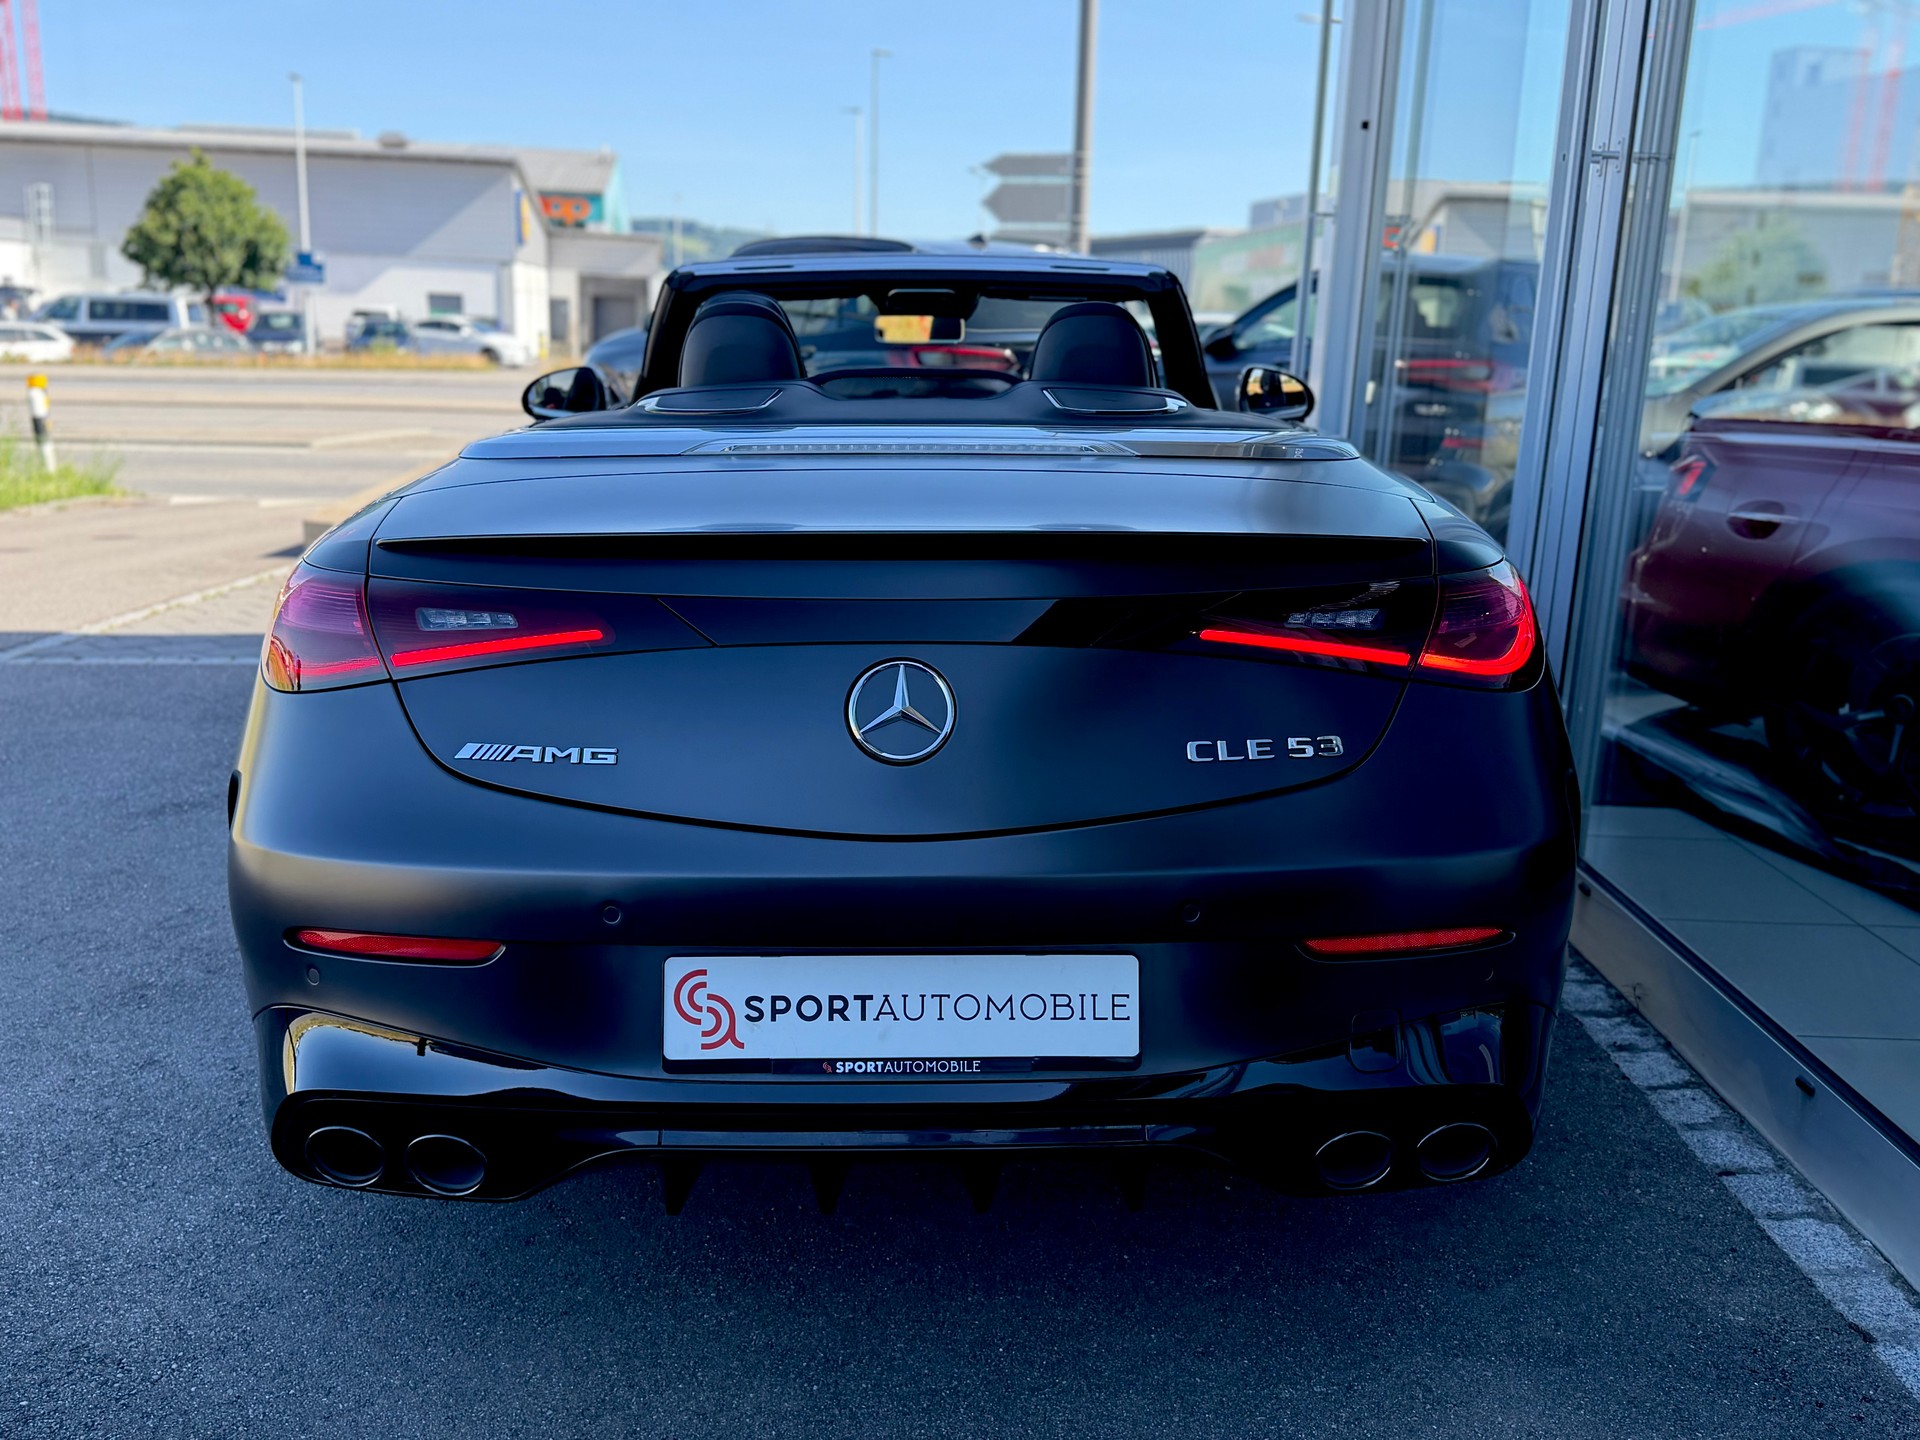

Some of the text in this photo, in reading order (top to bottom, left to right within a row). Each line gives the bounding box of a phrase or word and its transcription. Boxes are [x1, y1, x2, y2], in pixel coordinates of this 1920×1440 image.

[503, 745, 617, 765] AMG
[1186, 735, 1344, 762] CLE 53
[744, 993, 1131, 1023] SPORTAUTOMOBILE
[835, 1060, 981, 1073] SPORTAUTOMOBILE
